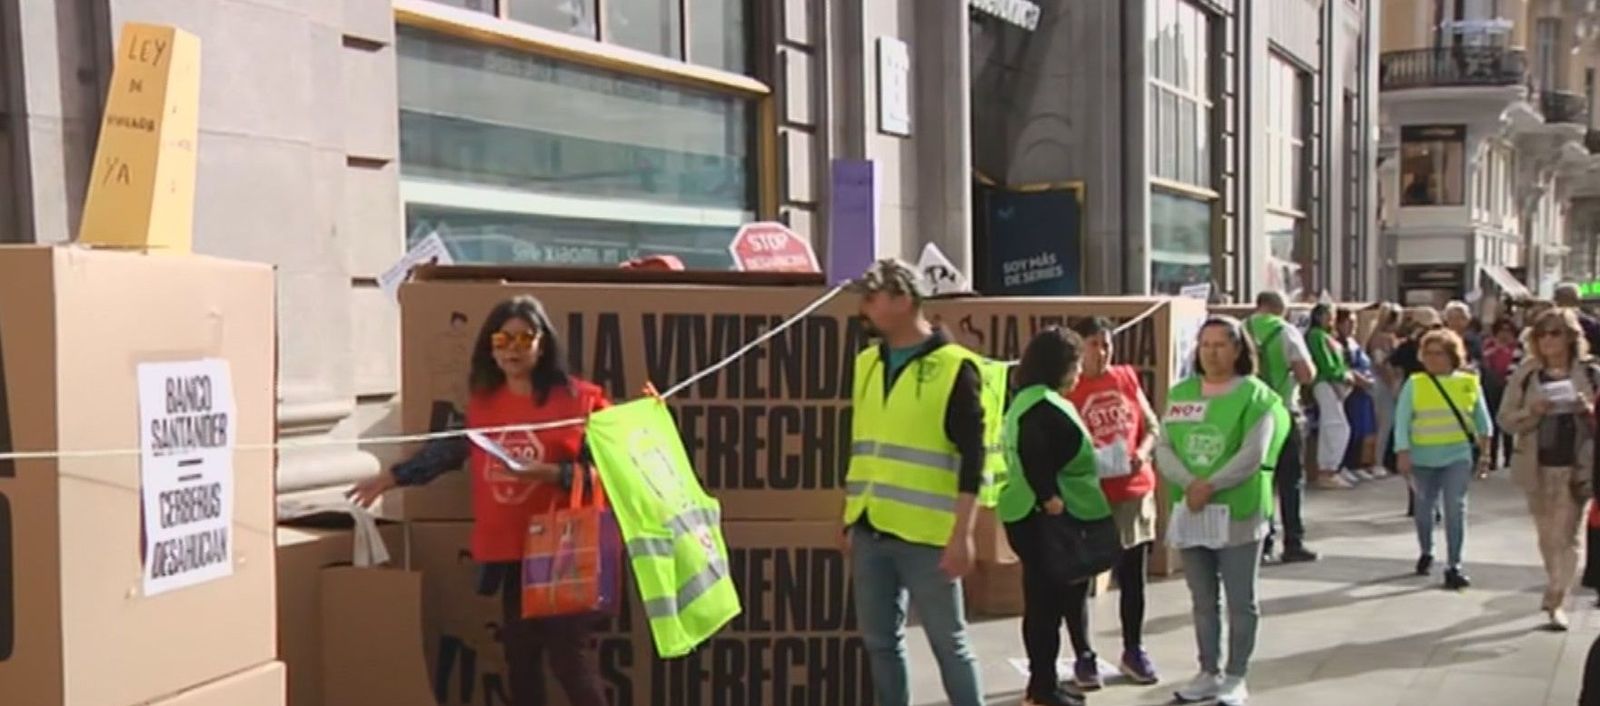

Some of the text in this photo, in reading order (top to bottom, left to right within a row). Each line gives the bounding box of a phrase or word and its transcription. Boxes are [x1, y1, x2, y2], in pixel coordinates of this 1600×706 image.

[128, 34, 166, 66] LEY
[103, 156, 130, 187] YA
[746, 231, 789, 253] STOP
[1003, 260, 1027, 275] SOY
[1004, 272, 1021, 288] DE
[567, 313, 628, 399] LA
[165, 375, 213, 414] BANCO
[151, 413, 228, 455] SANTANDER
[159, 482, 222, 530] CERBERUS
[151, 527, 229, 580] DESAHUCIAN
